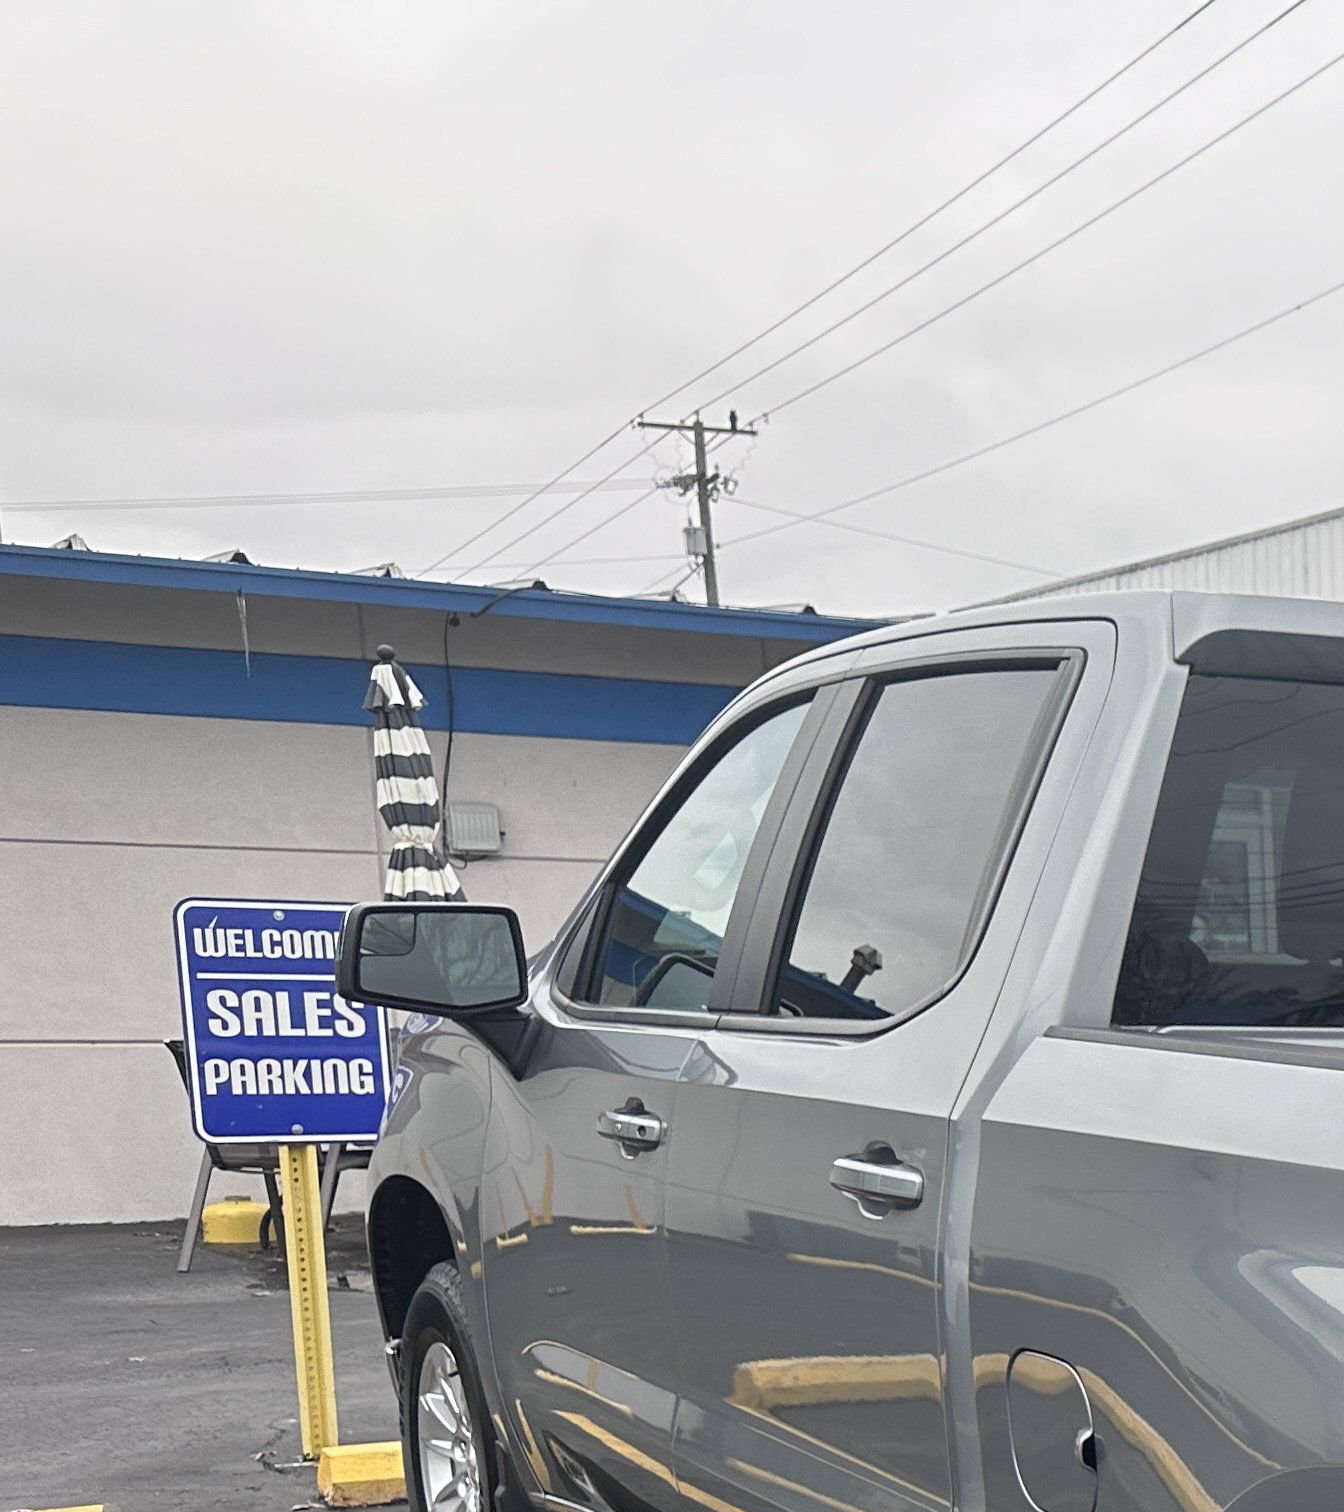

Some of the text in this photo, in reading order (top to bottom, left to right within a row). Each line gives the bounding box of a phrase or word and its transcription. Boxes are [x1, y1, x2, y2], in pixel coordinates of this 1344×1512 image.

[193, 915, 338, 960] WELCOM
[206, 989, 366, 1038] SALES
[204, 1058, 375, 1096] PARKING
